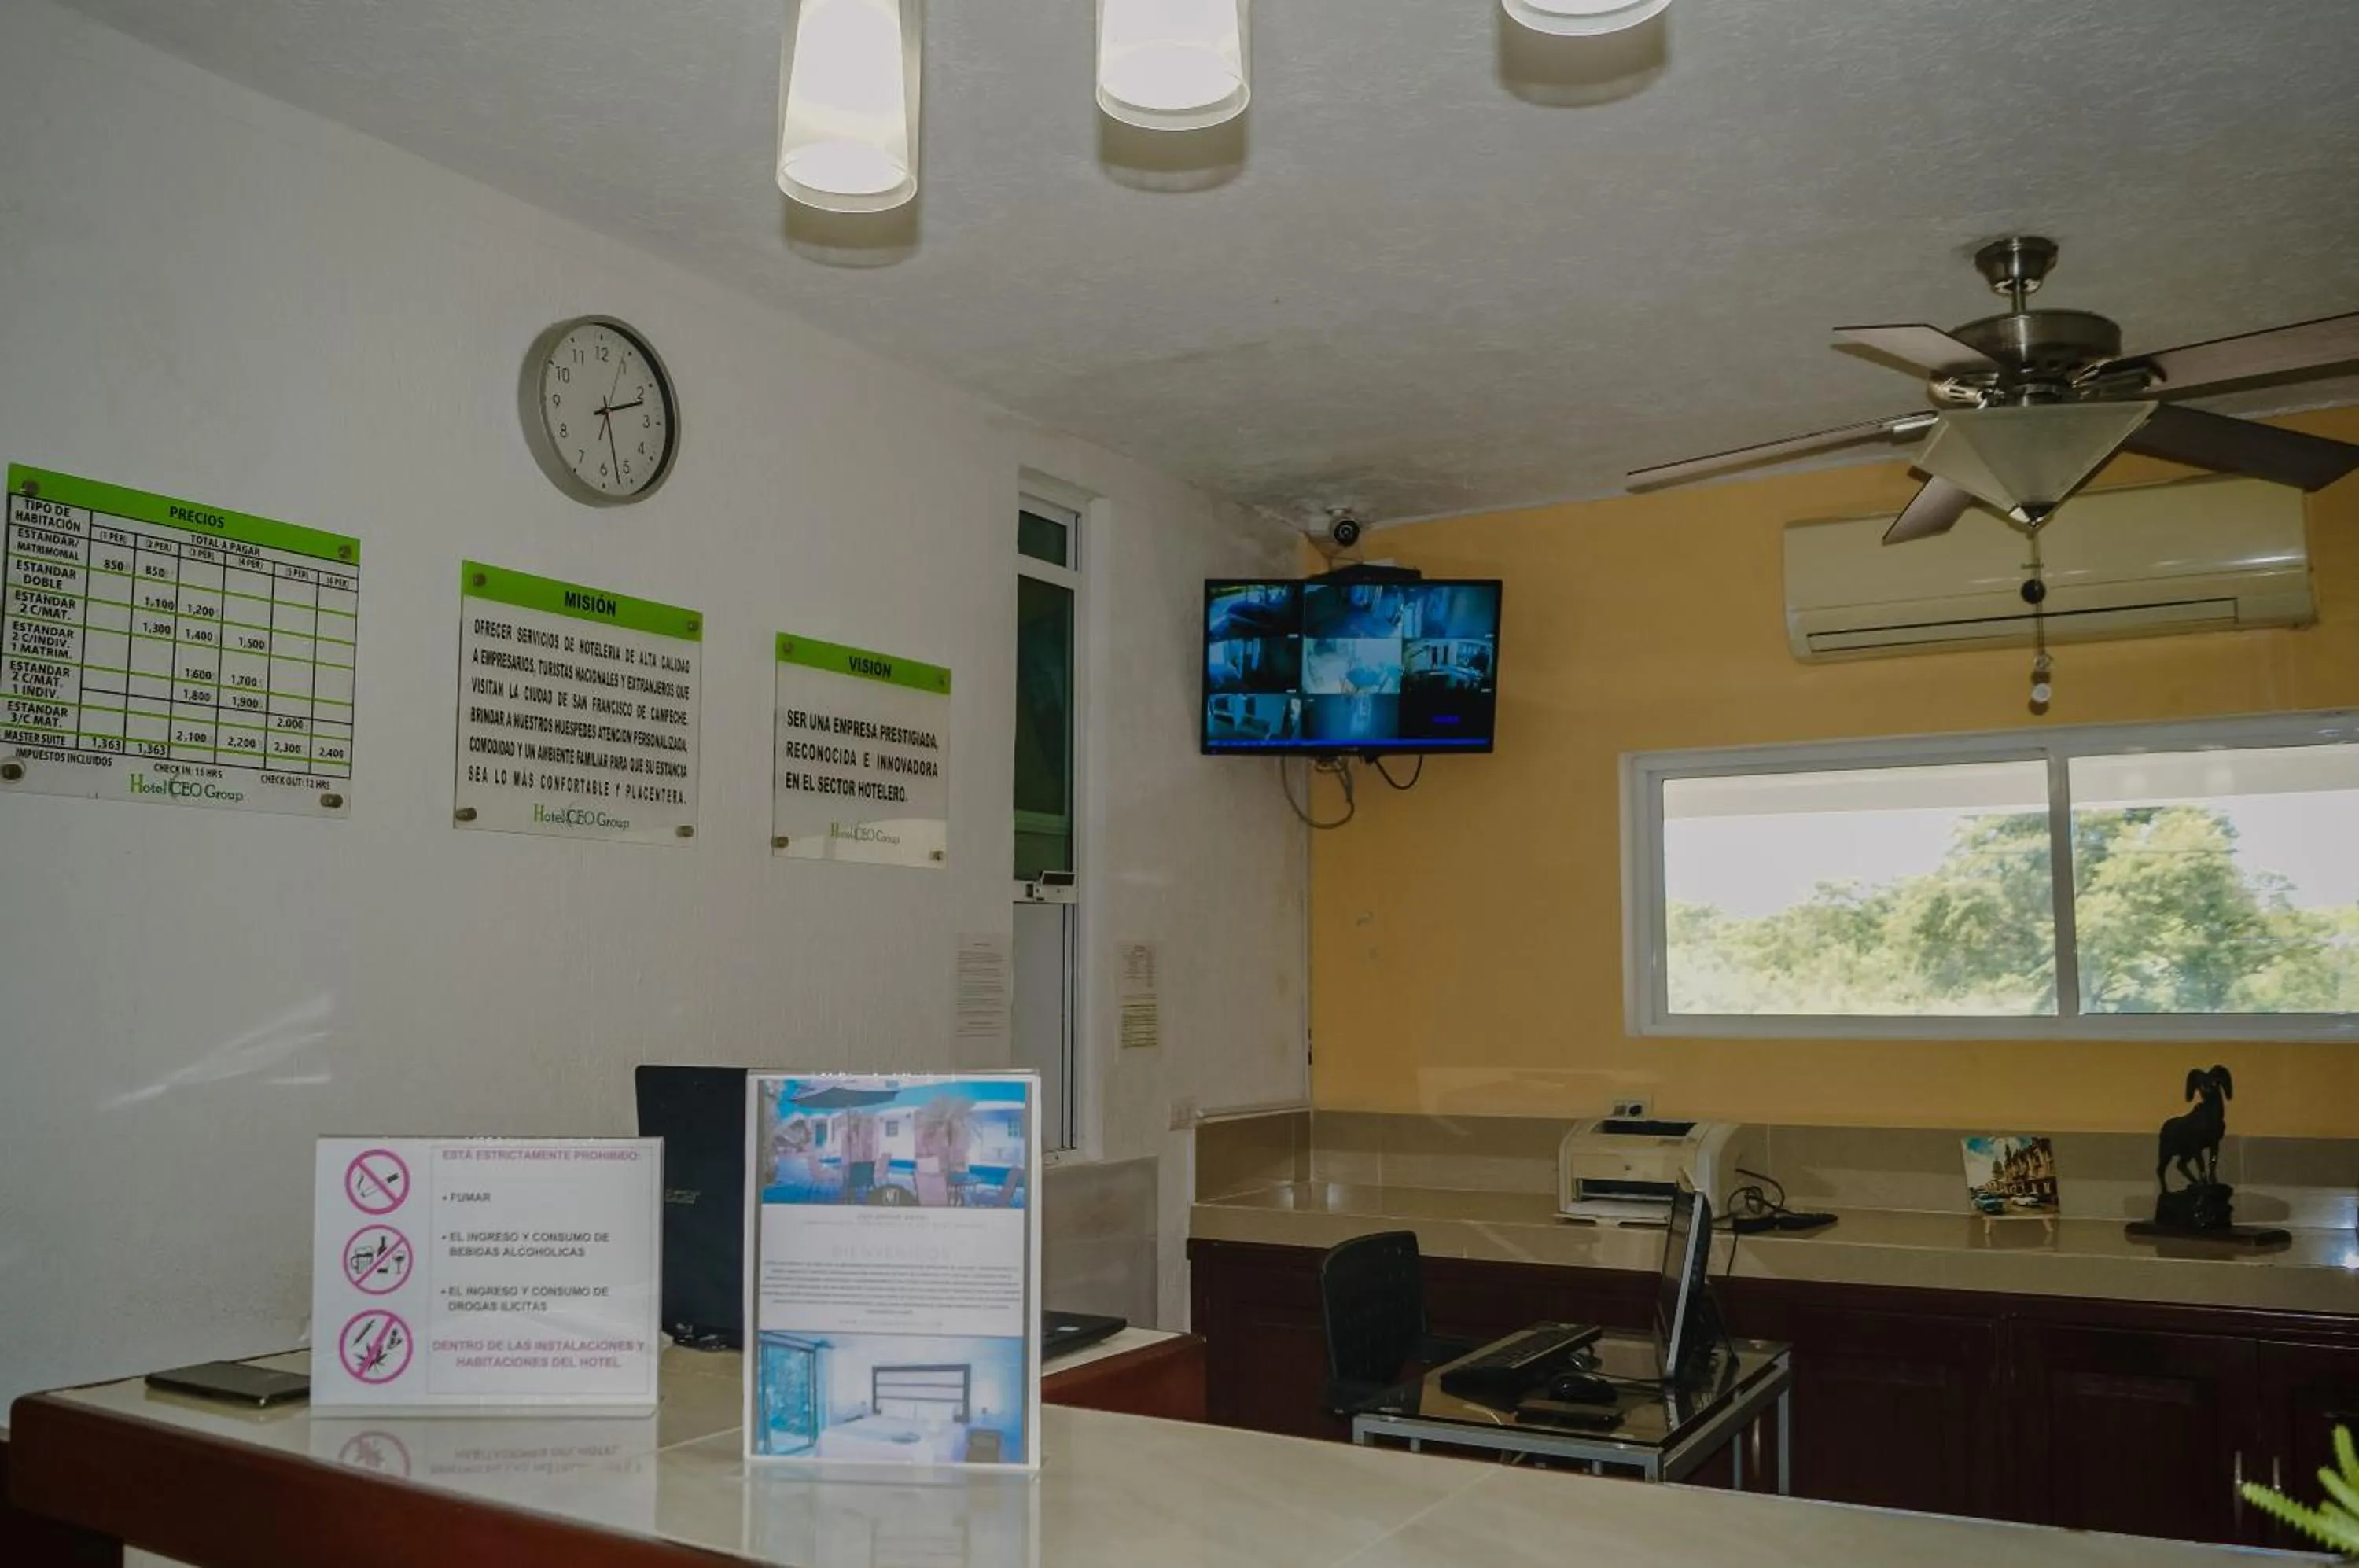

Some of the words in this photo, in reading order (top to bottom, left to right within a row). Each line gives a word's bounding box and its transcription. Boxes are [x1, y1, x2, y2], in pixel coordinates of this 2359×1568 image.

[572, 348, 585, 366] 11
[594, 345, 609, 363] 12
[556, 366, 570, 383] 10
[552, 394, 561, 407] 9
[635, 385, 645, 400] 2
[559, 423, 567, 438] 8
[642, 414, 651, 429] 3
[578, 449, 585, 464] 7
[637, 441, 645, 455] 4
[599, 462, 608, 477] 6
[622, 459, 631, 475] 5
[25, 499, 53, 514] TIPO
[55, 504, 71, 517] DE
[169, 505, 226, 529] PRECIOS
[15, 510, 81, 532] HABITACIÓN
[17, 541, 80, 561] MATRIMONIAL
[190, 534, 220, 550] TOTAL
[221, 539, 228, 550] A
[229, 543, 261, 557] PAGAR
[16, 559, 77, 580] ESTANDAR
[103, 558, 123, 571] 850
[145, 565, 165, 578] 850
[23, 573, 63, 591] DOBLE
[15, 589, 76, 609] ESTANDAR
[563, 591, 617, 617] MISIÓN
[19, 602, 28, 614] 2
[29, 604, 72, 621] C/MAT.
[11, 631, 19, 642] 2
[13, 620, 75, 640] ESTANDAR
[11, 642, 17, 652] 1
[20, 643, 72, 660] MATRIM.
[473, 617, 513, 641] OFRECER
[517, 626, 560, 649] SERVICIOS
[564, 635, 575, 653] DE
[625, 648, 635, 664] DE
[639, 650, 657, 668] ALTA
[9, 660, 70, 679] ESTANDAR
[11, 671, 19, 681] 2
[472, 647, 479, 667] A
[539, 659, 574, 680] TURISTAS
[575, 665, 619, 688] NACIONALES
[620, 673, 627, 688] Y
[676, 684, 690, 701] QUE
[12, 685, 18, 695] 1
[22, 685, 61, 701] INDIV.
[471, 675, 505, 698] VISITAN
[509, 683, 518, 699] LA
[524, 685, 553, 705] CIUDAD
[558, 691, 568, 707] DE
[572, 693, 588, 710] SAN
[591, 697, 633, 717] FRANCISCO
[636, 704, 646, 720] DE
[6, 700, 69, 719] ESTANDAR
[10, 712, 31, 727] 3/C
[33, 715, 63, 729] MAT.
[470, 705, 505, 727] BRINDAR
[506, 712, 512, 728] A
[513, 712, 554, 734] NUESTROS
[554, 717, 597, 740] HUESPEDES
[787, 709, 808, 729] SER
[809, 712, 831, 733] UNA
[833, 716, 878, 741] EMPRESA
[4, 728, 39, 744] MASTER
[41, 733, 66, 747] SUITE
[15, 747, 66, 763] IMPUESTOS
[67, 755, 113, 767] INCLUIDOS
[469, 735, 515, 757] COMODIDAD
[517, 742, 523, 759] Y
[524, 742, 535, 760] UN
[576, 748, 609, 769] FAMILIAR
[609, 754, 627, 771] PARA
[630, 757, 644, 774] QUE
[646, 758, 655, 775] SU
[786, 740, 857, 767] RECONOCIDA
[863, 752, 870, 768] E
[877, 753, 939, 778] INNOVADORA
[153, 761, 180, 774] CHECK
[206, 768, 223, 779] HRS
[260, 774, 285, 786] CHECK
[315, 778, 331, 790] HRS
[468, 764, 488, 784] SEA
[494, 767, 507, 786] LO
[540, 773, 609, 797] CONFORTABLE
[626, 783, 687, 805] PLACENTERA.
[786, 771, 800, 791] EN
[802, 773, 815, 792] EL
[817, 775, 857, 797] SECTOR
[858, 779, 908, 803] HOTELERO.
[204, 785, 244, 804] Group
[476, 1149, 572, 1161] ESTRICTAMENTE
[450, 1192, 491, 1202] FUMAR
[449, 1232, 464, 1243] EL
[466, 1232, 519, 1243] INGRESO
[521, 1232, 529, 1243] Y
[532, 1232, 591, 1243] CONSUMO
[594, 1232, 611, 1244] DE
[449, 1246, 500, 1258] BEBIDAS
[448, 1286, 463, 1297] EL
[466, 1286, 519, 1297] INGRESO
[521, 1286, 529, 1297] Y
[531, 1286, 591, 1297] CONSUMO
[592, 1286, 610, 1297] DE
[447, 1301, 499, 1312] DROGAS
[500, 1300, 548, 1312] ILICITAS
[432, 1340, 484, 1352] DENTRO
[488, 1341, 504, 1352] DE
[506, 1341, 532, 1352] LAS
[535, 1340, 635, 1353] INSTALACIONES
[636, 1340, 646, 1352] Y
[455, 1356, 550, 1369] HABITACIONES
[551, 1357, 576, 1369] DEL
